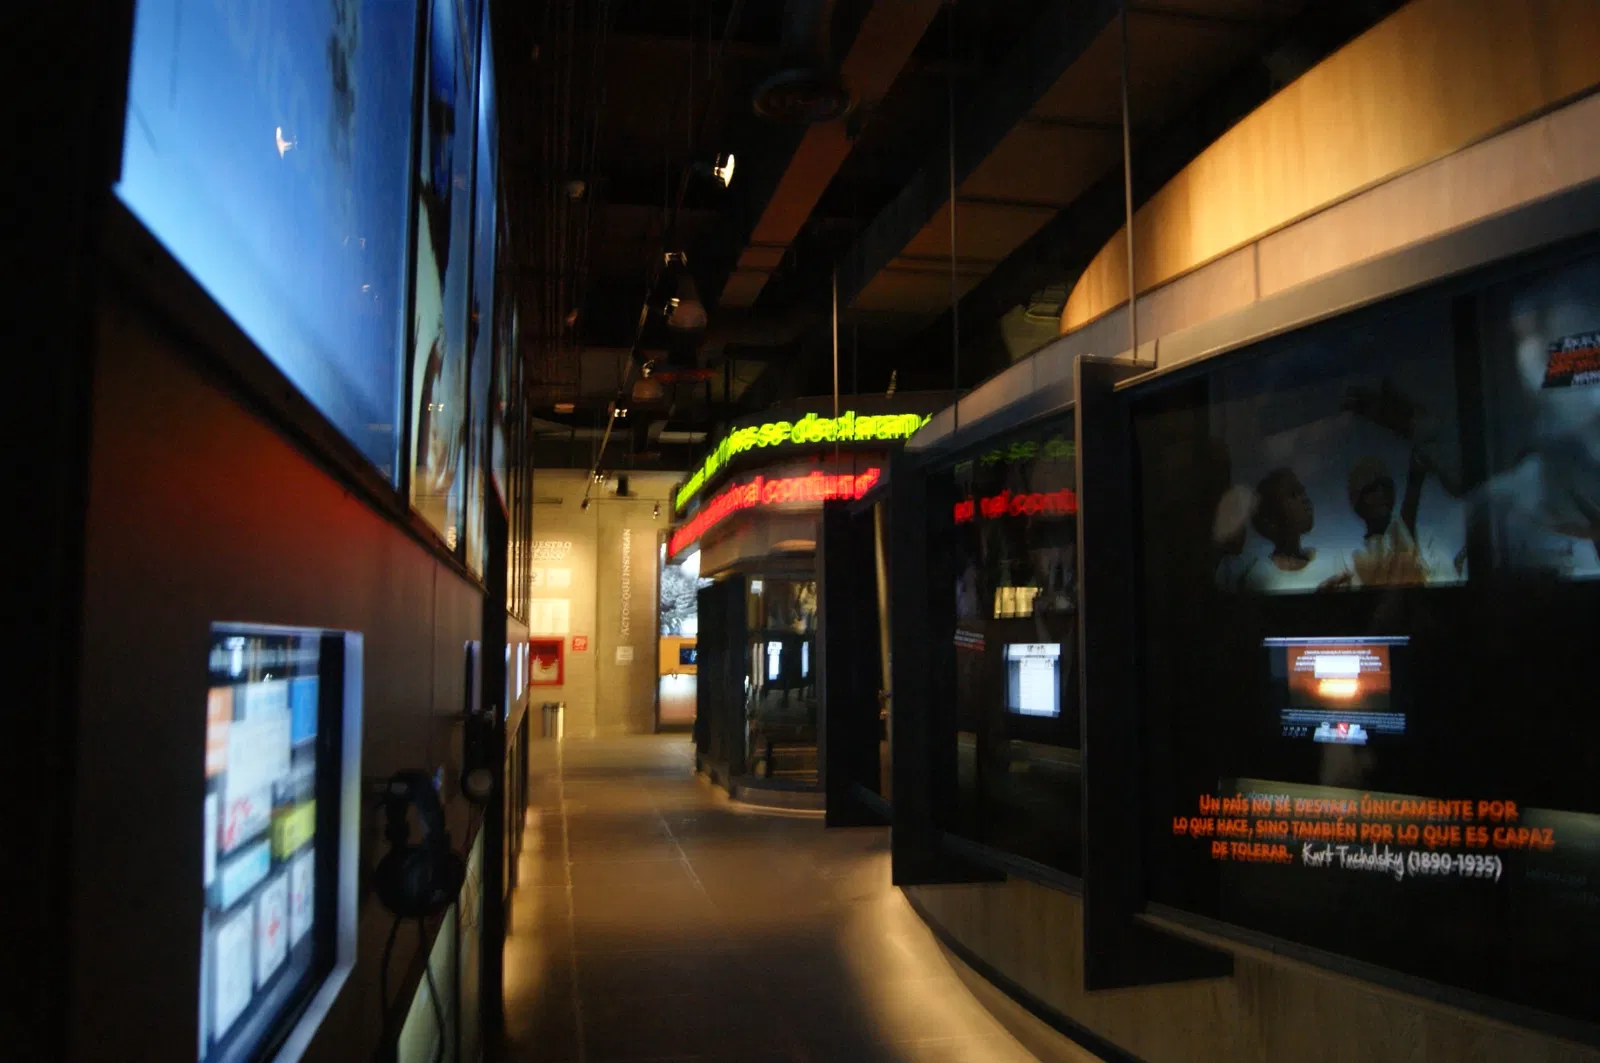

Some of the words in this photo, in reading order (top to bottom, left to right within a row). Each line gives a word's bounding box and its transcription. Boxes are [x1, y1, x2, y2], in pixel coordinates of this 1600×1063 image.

[1222, 793, 1249, 815] PAÍS
[1252, 797, 1273, 815] NO
[1360, 794, 1473, 818] ÚNICAMENTE
[1477, 800, 1518, 819] POR
[1173, 817, 1188, 834] LO
[1190, 818, 1214, 836] QUE
[1216, 819, 1253, 838] HACE,
[1256, 820, 1289, 837] SINO
[1291, 816, 1356, 838] TAMBIÉN
[1360, 823, 1393, 842] POR
[1397, 824, 1419, 843] LO
[1423, 825, 1460, 846] QUE
[1465, 826, 1488, 845] ES
[1492, 826, 1555, 847] CAPAZ
[1212, 841, 1228, 858] DE
[1302, 841, 1334, 865] Kurt
[1336, 844, 1404, 880] Tucholsky
[1408, 852, 1502, 882] (1890-1935)
